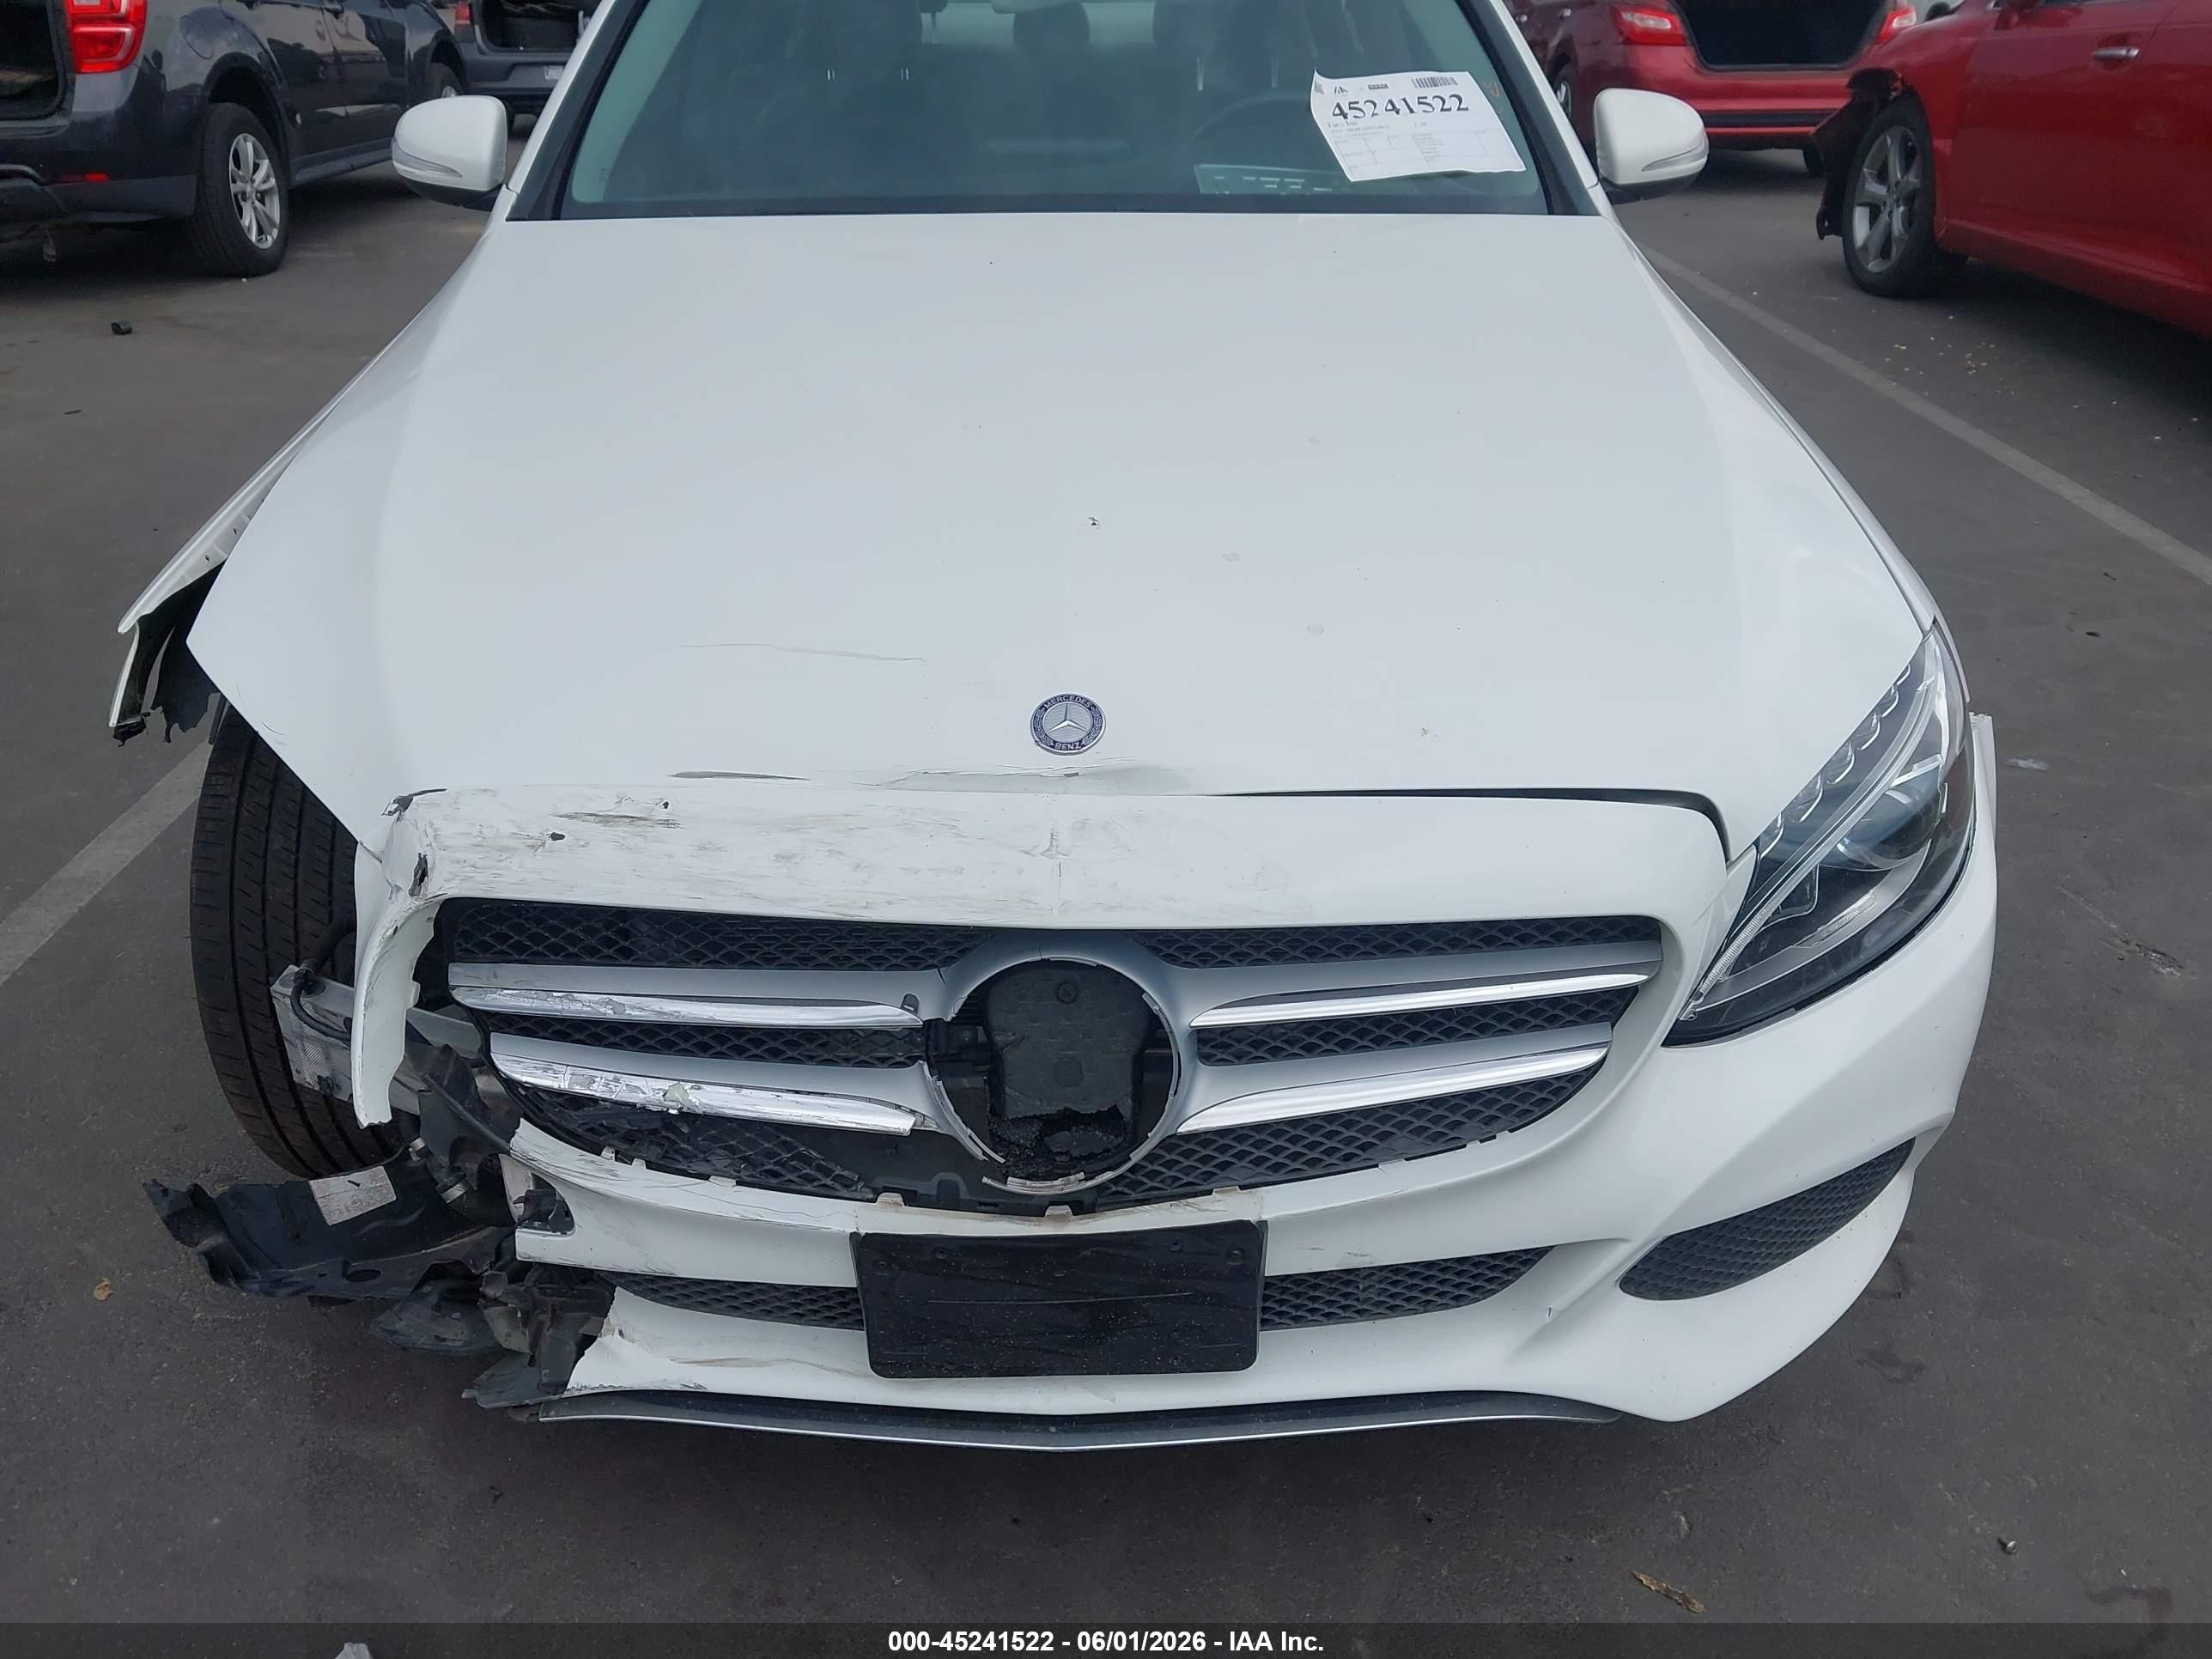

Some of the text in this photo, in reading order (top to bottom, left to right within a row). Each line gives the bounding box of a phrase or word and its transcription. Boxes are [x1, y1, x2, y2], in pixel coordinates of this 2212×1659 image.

[1332, 93, 1470, 120] 45241522
[1043, 694, 1093, 709] MERCEDES
[1054, 742, 1082, 750] BENZ
